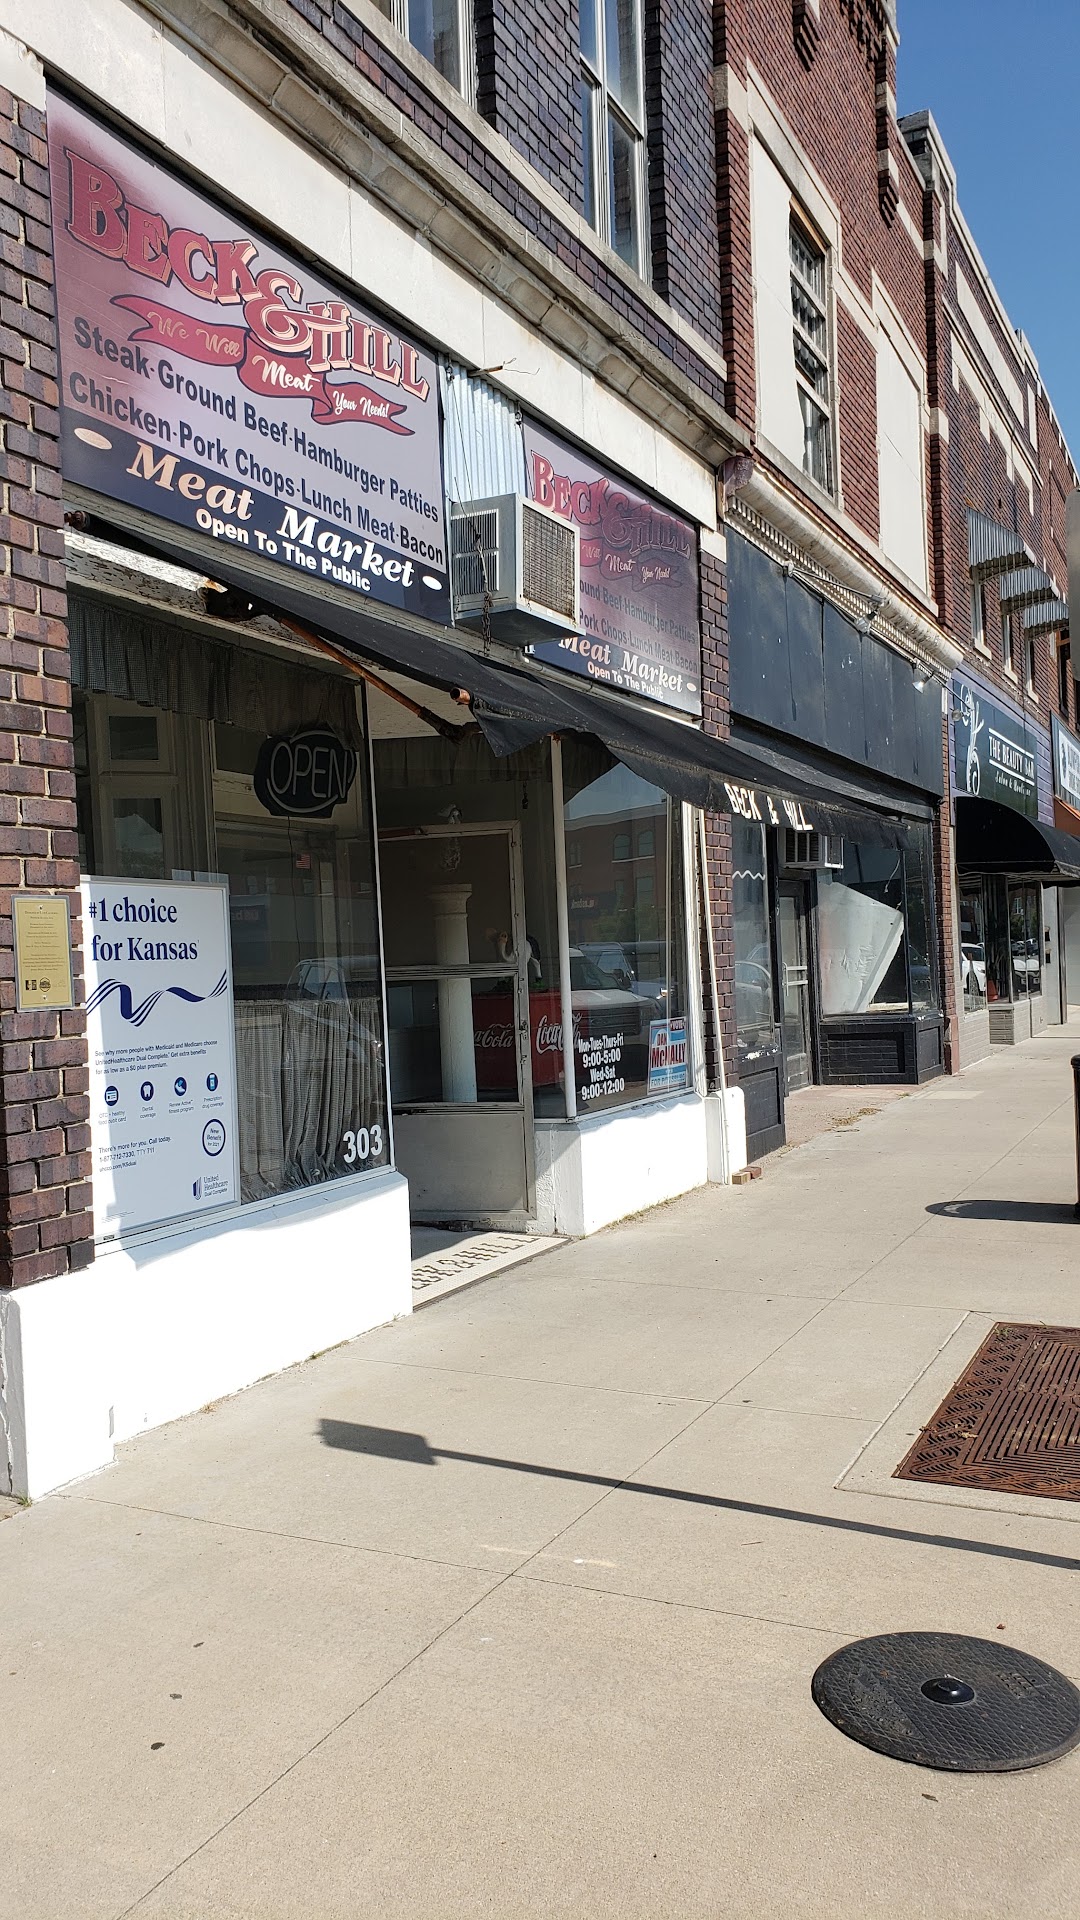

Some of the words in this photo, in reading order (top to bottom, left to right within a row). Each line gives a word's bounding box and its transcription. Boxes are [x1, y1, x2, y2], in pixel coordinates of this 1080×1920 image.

[63, 146, 259, 306] BECK
[243, 268, 350, 355] &
[306, 301, 430, 402] HILL
[147, 311, 190, 339] We
[195, 328, 241, 357] Will
[252, 355, 321, 393] Meat
[333, 391, 357, 416] Your
[360, 397, 390, 418] Needs!
[390, 478, 439, 523] Patties
[531, 450, 610, 525] BECK
[126, 442, 255, 520] Meat
[276, 506, 415, 587] Market
[196, 508, 249, 545] Open
[254, 531, 278, 554] To
[282, 542, 317, 570] The
[321, 558, 371, 591] Public
[605, 554, 636, 573] Meat
[669, 619, 697, 644] Patties
[558, 636, 611, 664] Meat
[621, 650, 683, 693] Market
[587, 661, 610, 680] Open
[612, 670, 623, 684] To
[624, 674, 640, 690] The
[641, 682, 664, 699] Public
[271, 741, 348, 798] OPEN
[989, 736, 1001, 761] THE
[1002, 744, 1023, 772] BEAUTY
[724, 782, 762, 820] BECK
[88, 898, 109, 922] #1
[112, 897, 178, 923] choice
[91, 935, 123, 961] for
[127, 937, 198, 961] Kansas
[129, 1046, 144, 1054] people
[583, 1048, 621, 1068] 9:00-5:00
[581, 1077, 625, 1101] 9:00-12:00
[343, 1124, 383, 1163] 303
